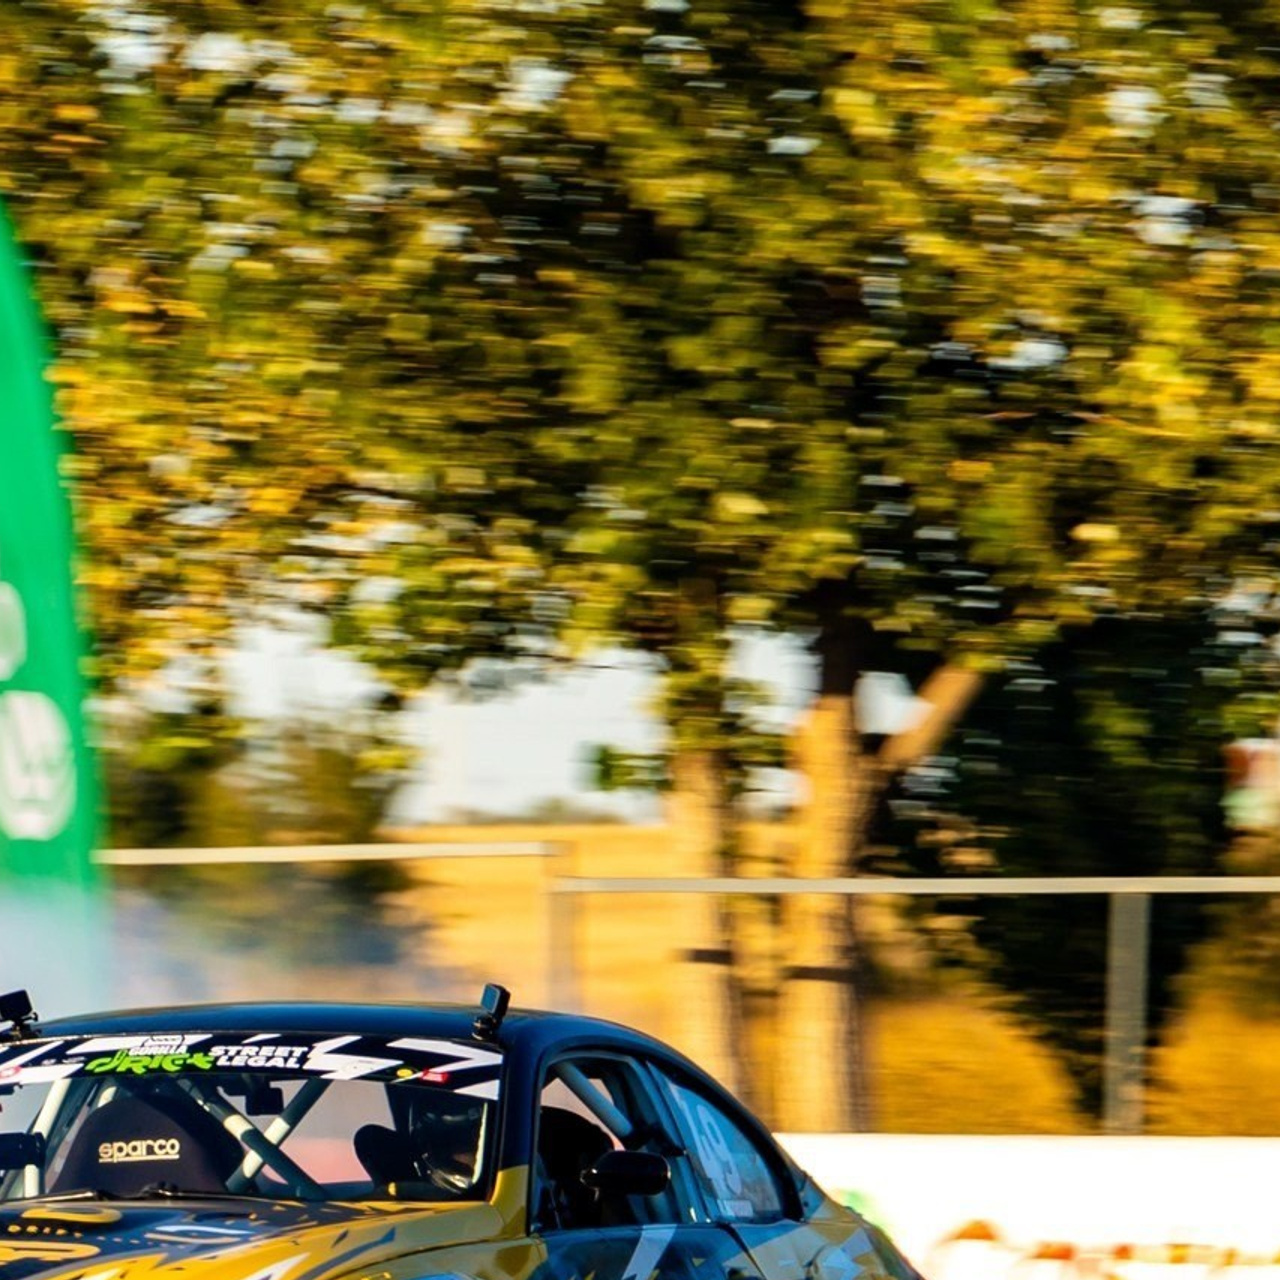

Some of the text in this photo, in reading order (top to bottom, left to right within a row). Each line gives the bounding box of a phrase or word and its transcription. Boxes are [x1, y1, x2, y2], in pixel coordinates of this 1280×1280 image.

[210, 1045, 308, 1059] STREET
[216, 1055, 301, 1069] LEGAL
[98, 1138, 181, 1163] sparco
